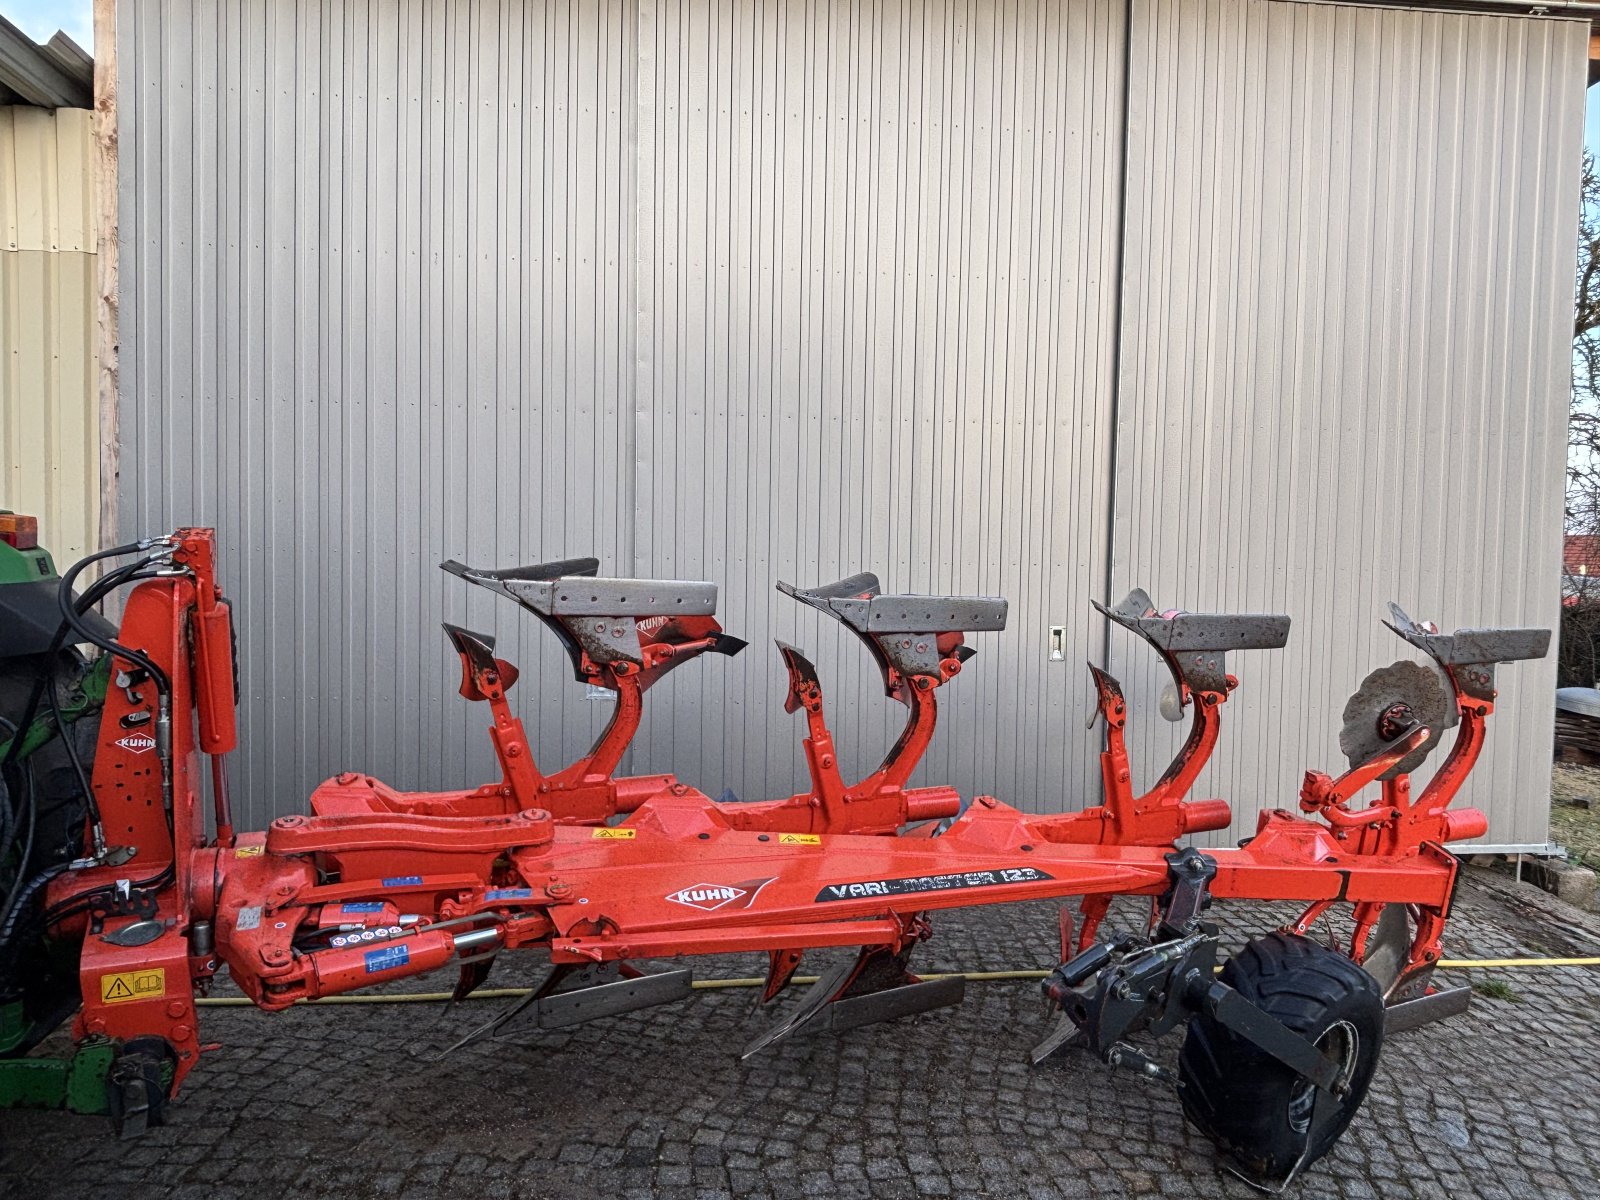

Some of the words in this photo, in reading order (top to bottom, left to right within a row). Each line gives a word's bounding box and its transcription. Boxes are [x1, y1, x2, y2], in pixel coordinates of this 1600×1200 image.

[640, 616, 664, 631] KUHN
[120, 738, 157, 747] KUHN
[1000, 868, 1040, 882] 123
[677, 888, 736, 903] KUHN
